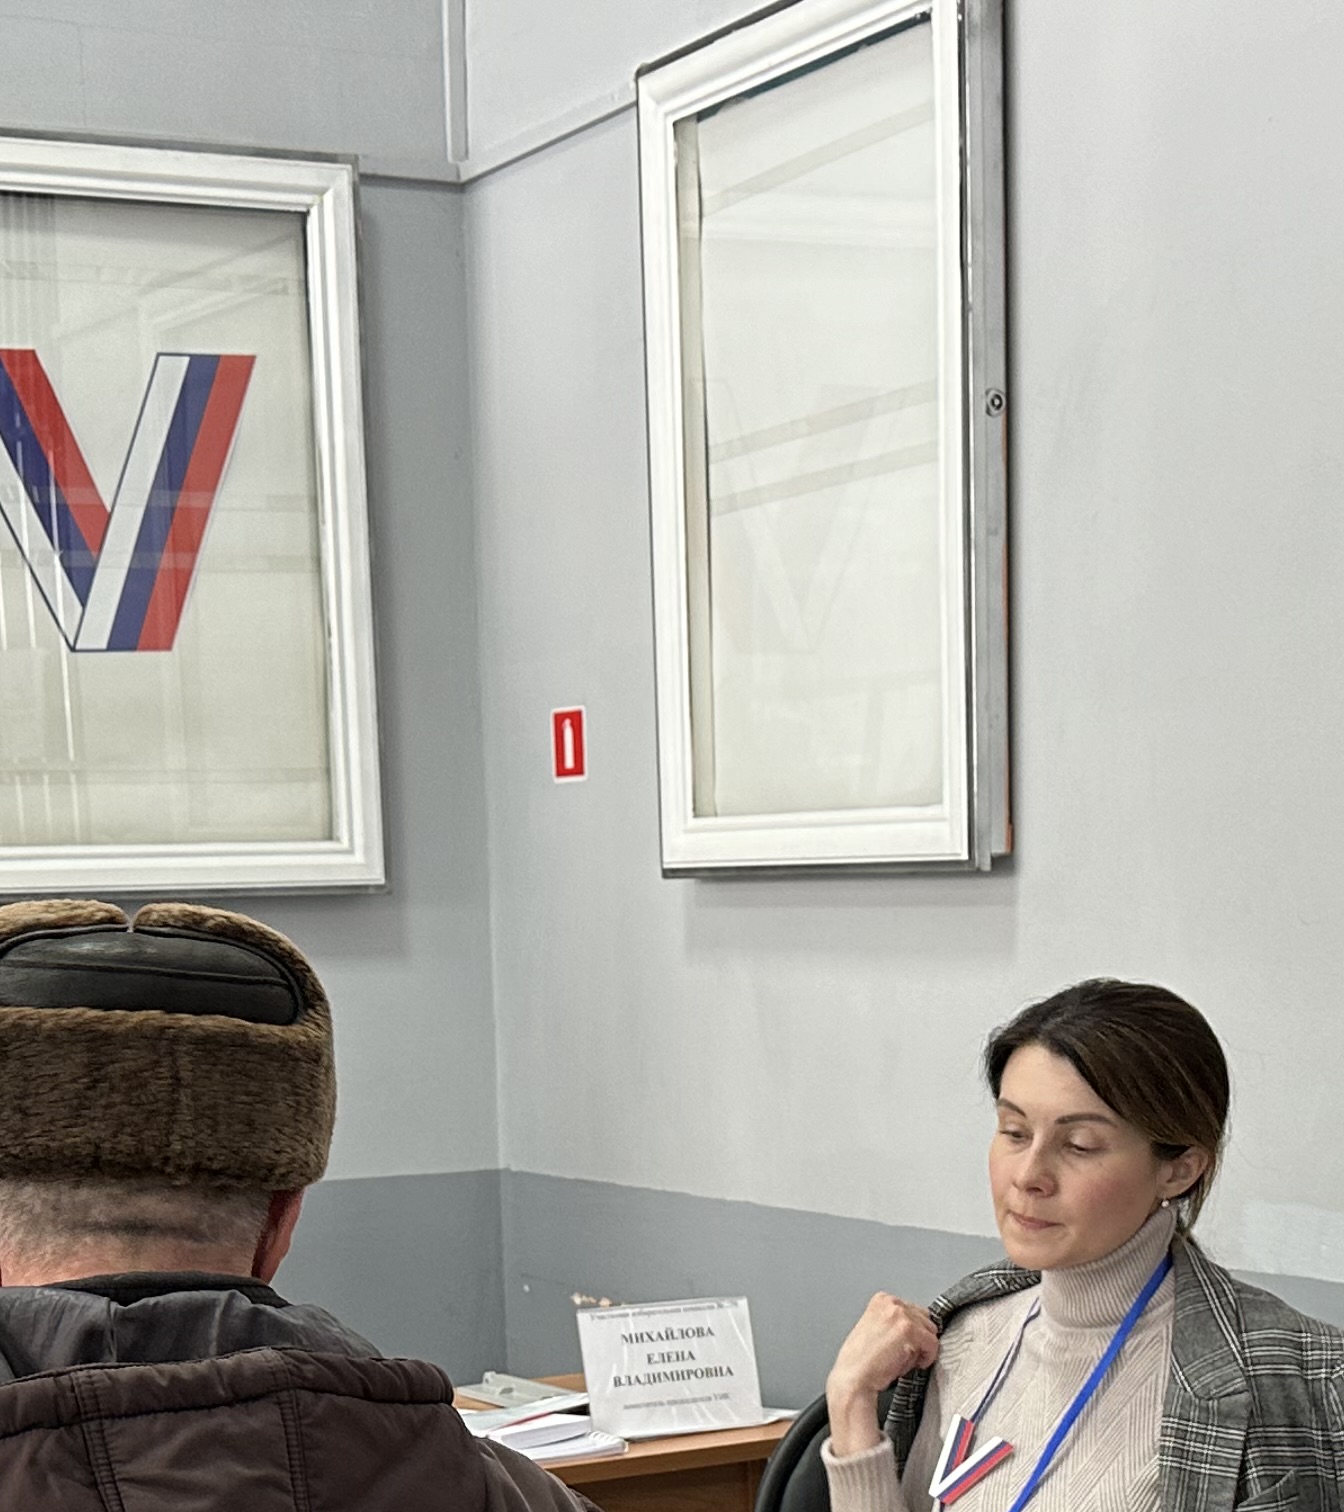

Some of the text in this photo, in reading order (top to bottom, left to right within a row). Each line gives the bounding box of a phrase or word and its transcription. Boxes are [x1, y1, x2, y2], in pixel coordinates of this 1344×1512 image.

[620, 1326, 715, 1346] МИХАЙЛОВА
[646, 1350, 696, 1366] ЕЛЕНА
[612, 1365, 735, 1388] ВЛАДИМИРОВНА
